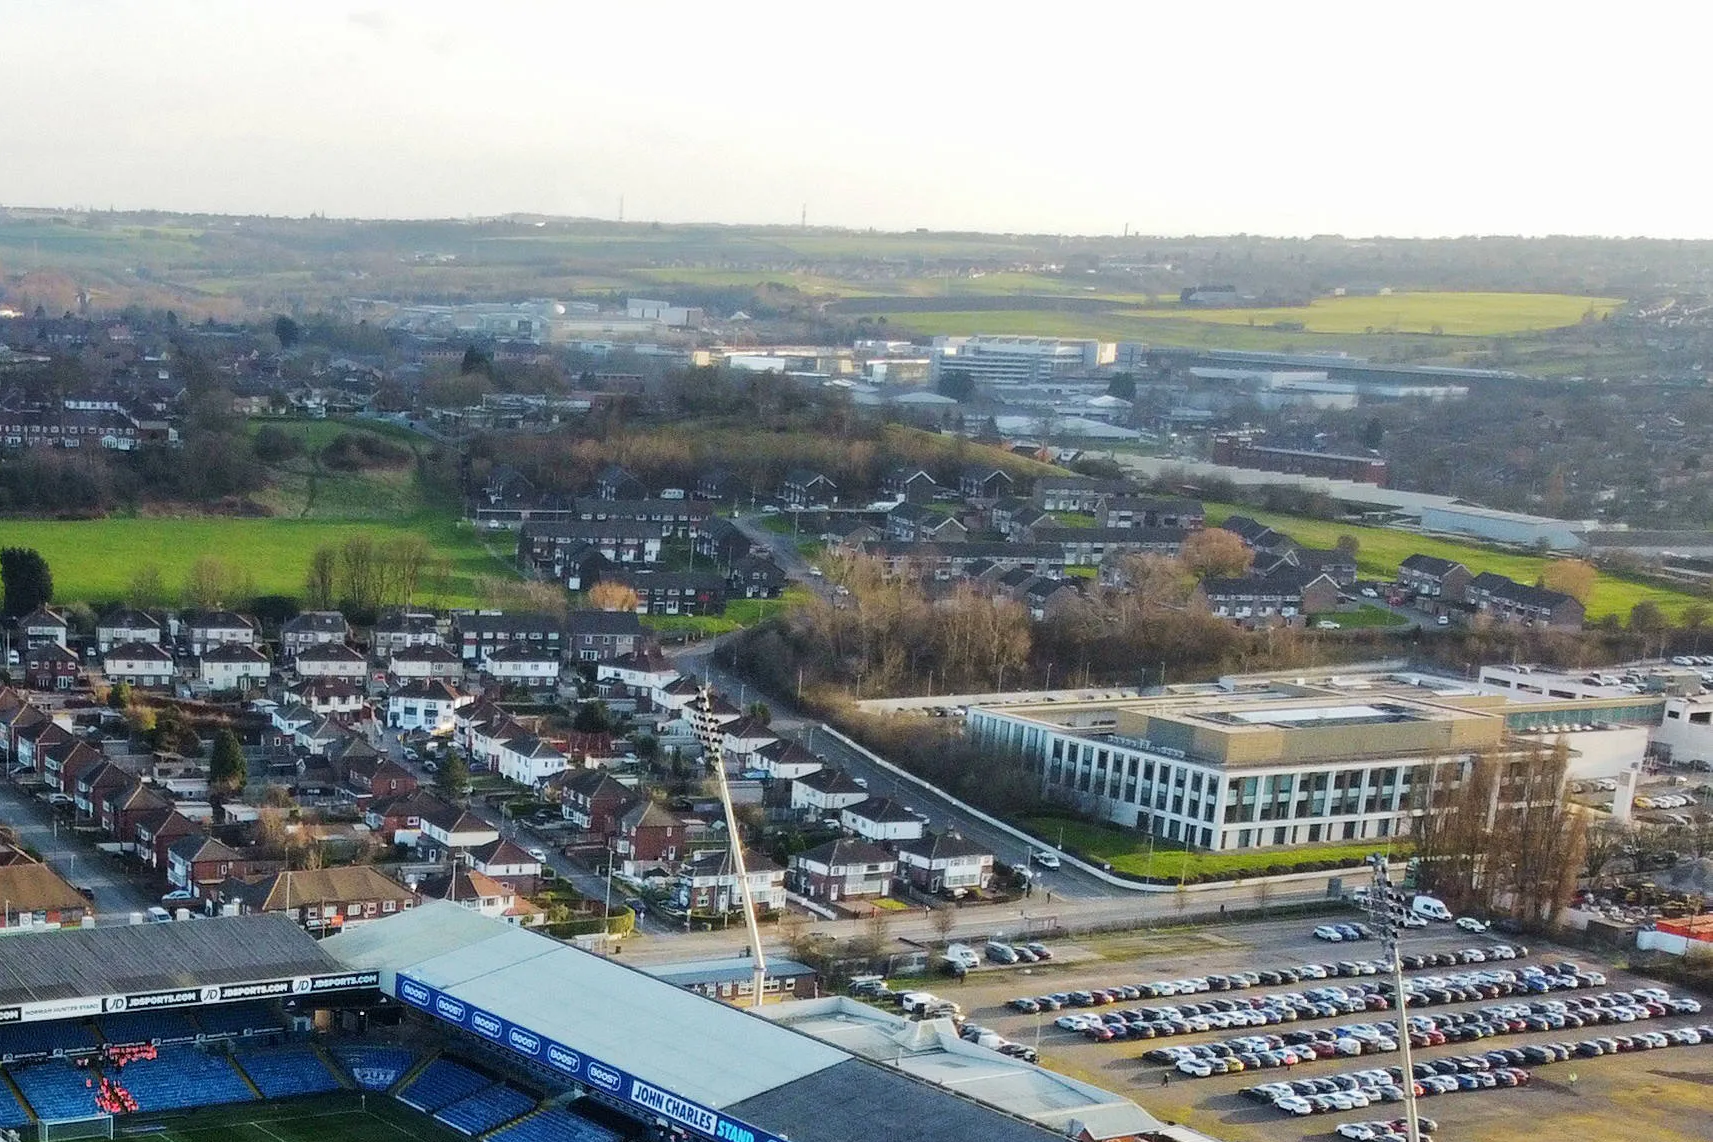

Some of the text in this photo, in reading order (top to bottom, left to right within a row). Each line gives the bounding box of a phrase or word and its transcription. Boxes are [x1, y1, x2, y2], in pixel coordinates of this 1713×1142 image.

[439, 1000, 462, 1016] BOOST
[474, 1015, 500, 1033] BOOST
[511, 1031, 538, 1049] BOOST
[550, 1049, 578, 1067] BOOST
[590, 1067, 619, 1086] BOOST
[634, 1085, 664, 1109] JOHN
[665, 1098, 712, 1131] CHARLES
